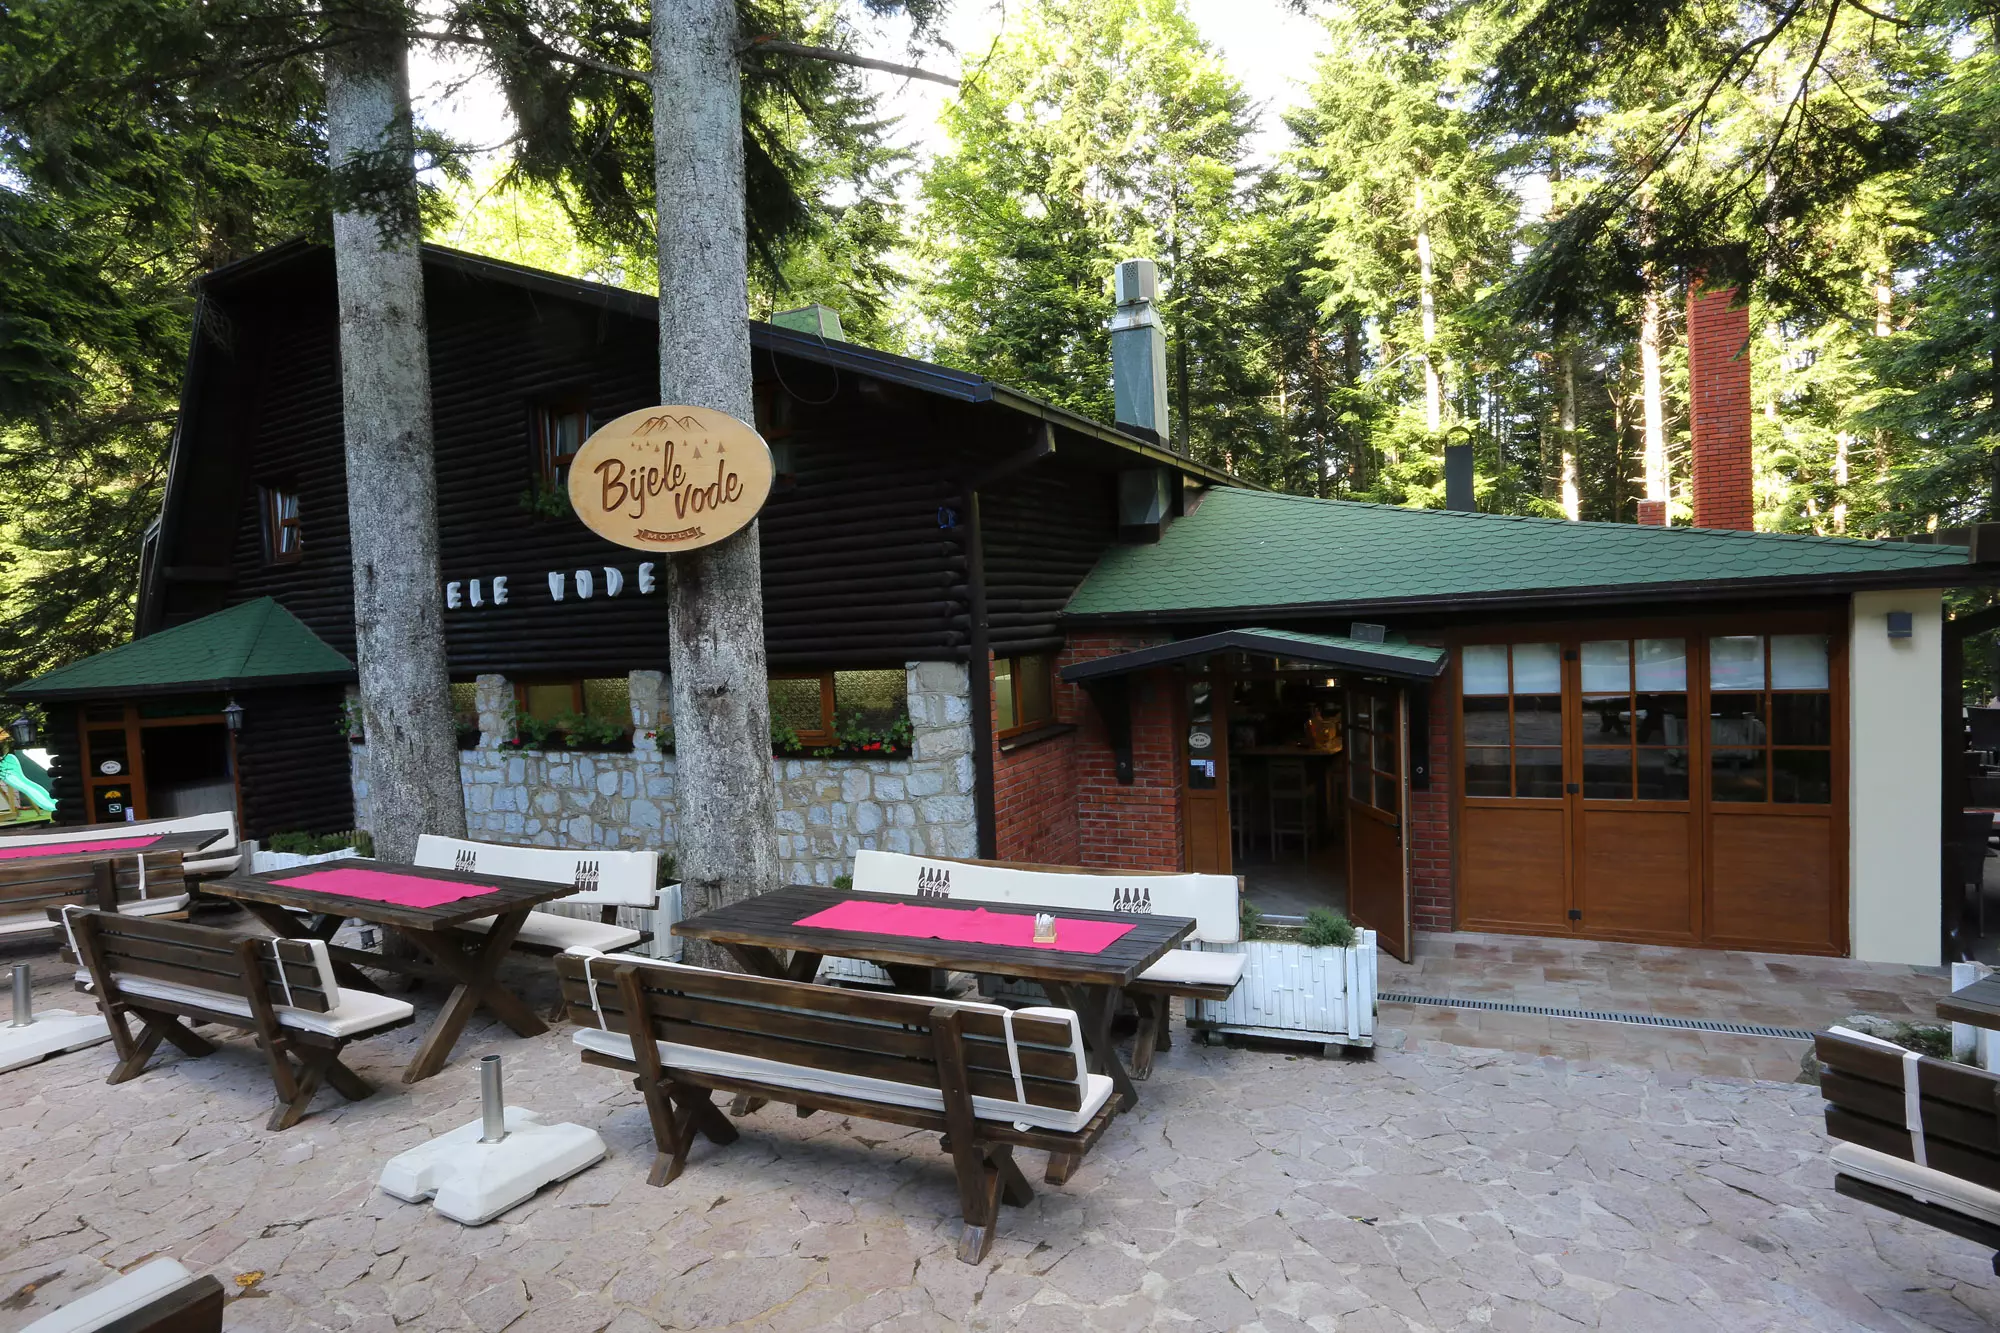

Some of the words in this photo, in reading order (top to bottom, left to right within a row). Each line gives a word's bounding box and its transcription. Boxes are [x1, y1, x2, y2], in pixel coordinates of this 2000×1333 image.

[593, 440, 687, 520] Bijele
[647, 530, 694, 540] MOTEL
[446, 576, 509, 609] ELE
[548, 562, 656, 601] VODE
